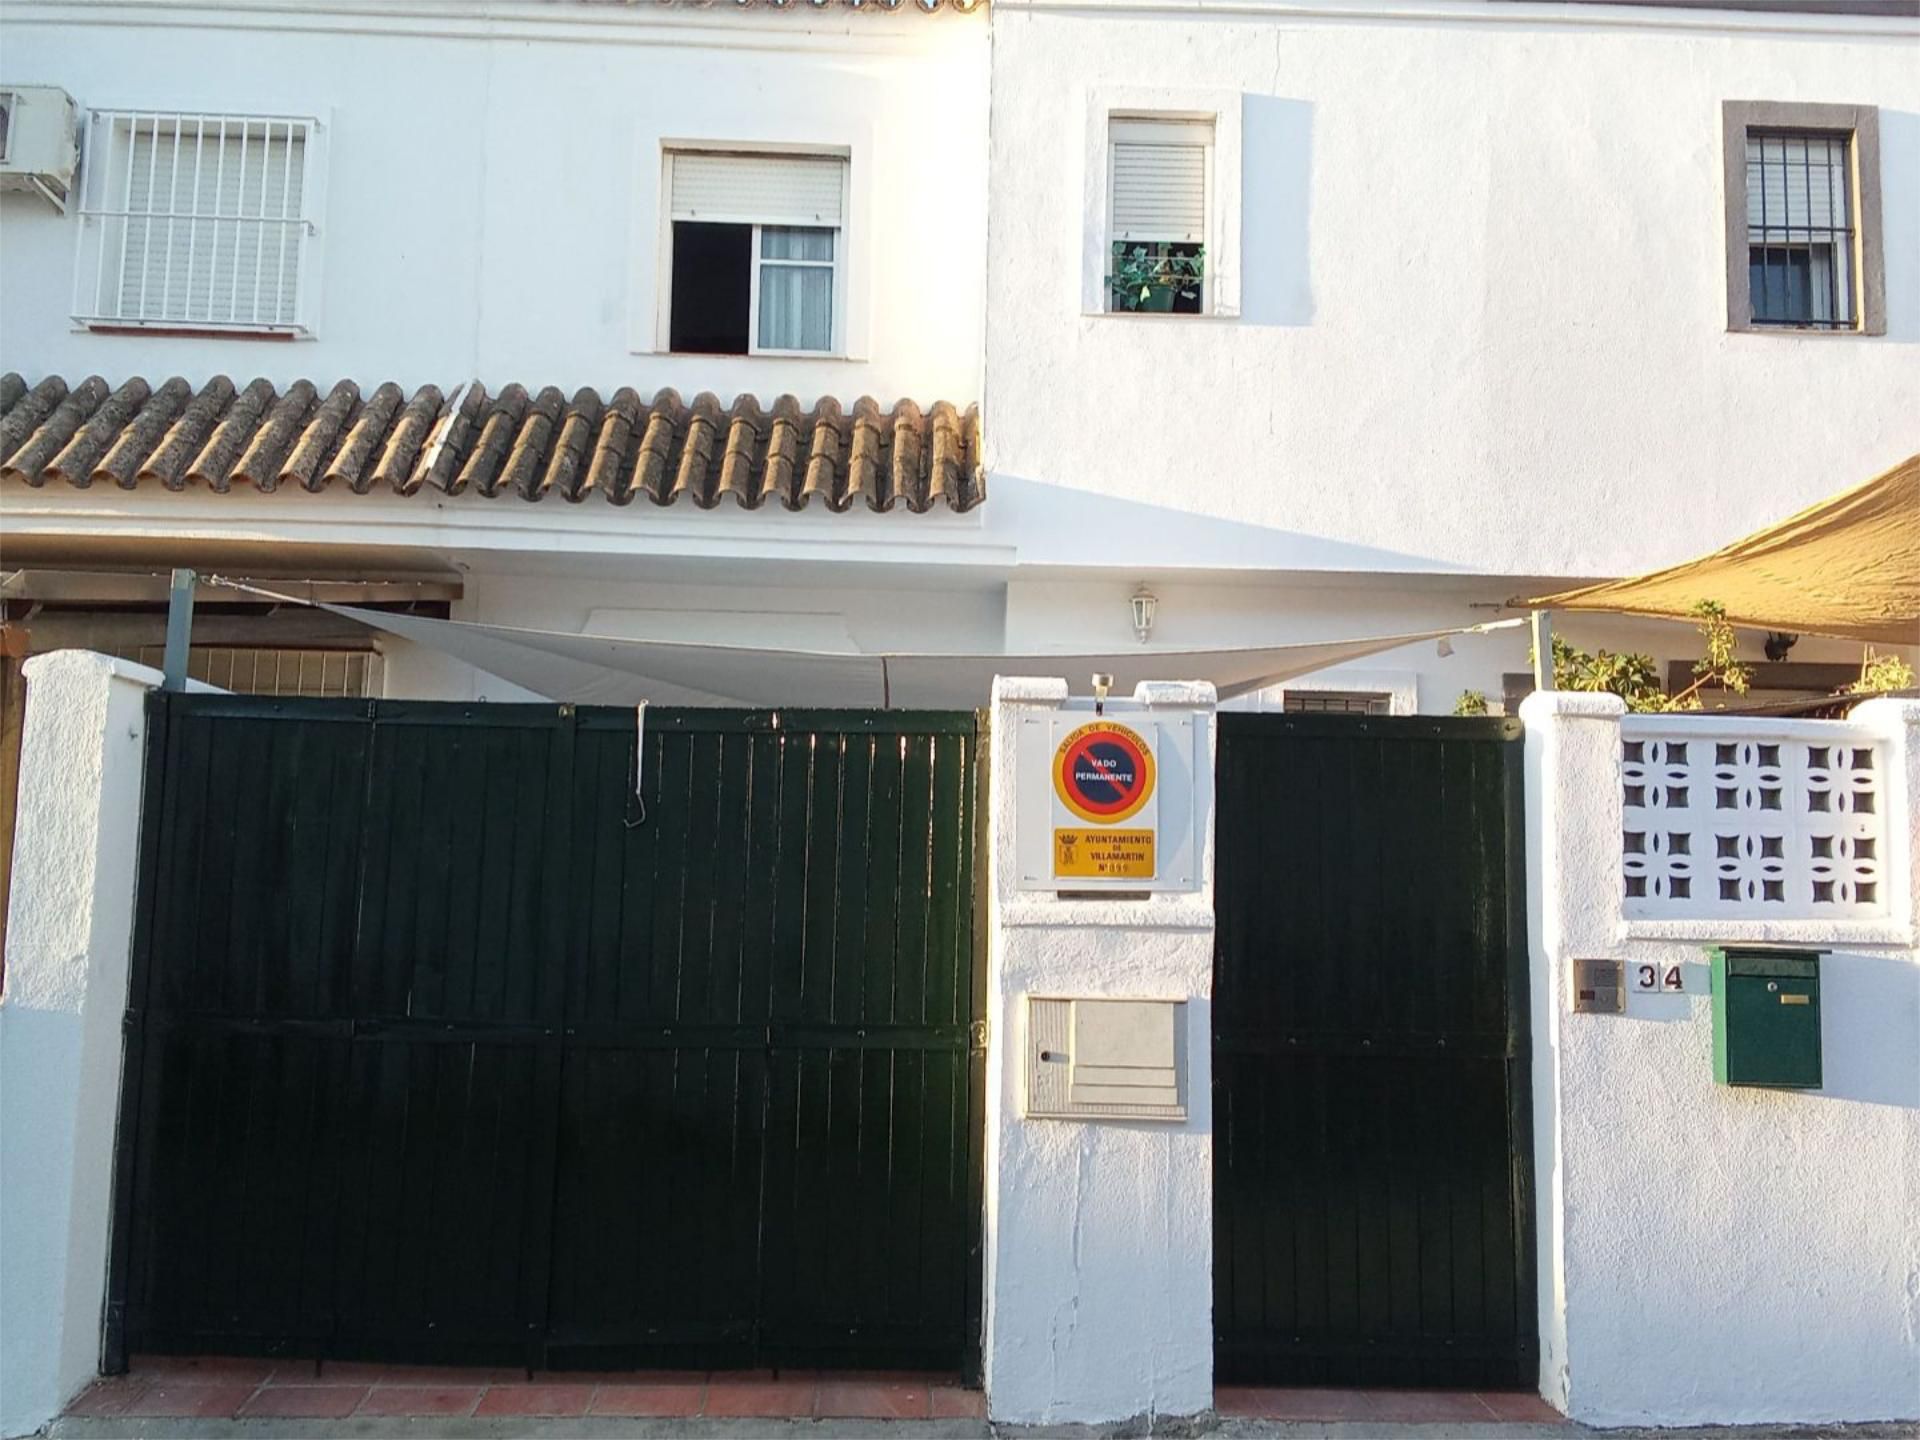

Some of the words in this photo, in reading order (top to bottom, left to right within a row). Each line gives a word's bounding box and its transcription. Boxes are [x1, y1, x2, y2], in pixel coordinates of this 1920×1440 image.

[1059, 728, 1085, 753] SALIDA
[1088, 724, 1099, 732] DE
[1091, 759, 1117, 768] VADO
[1075, 772, 1133, 782] PERMANENTE
[1085, 834, 1152, 844] AYUNTAMIENTO
[1090, 852, 1145, 861] VILLAMARTIN
[1639, 965, 1682, 989] 34
